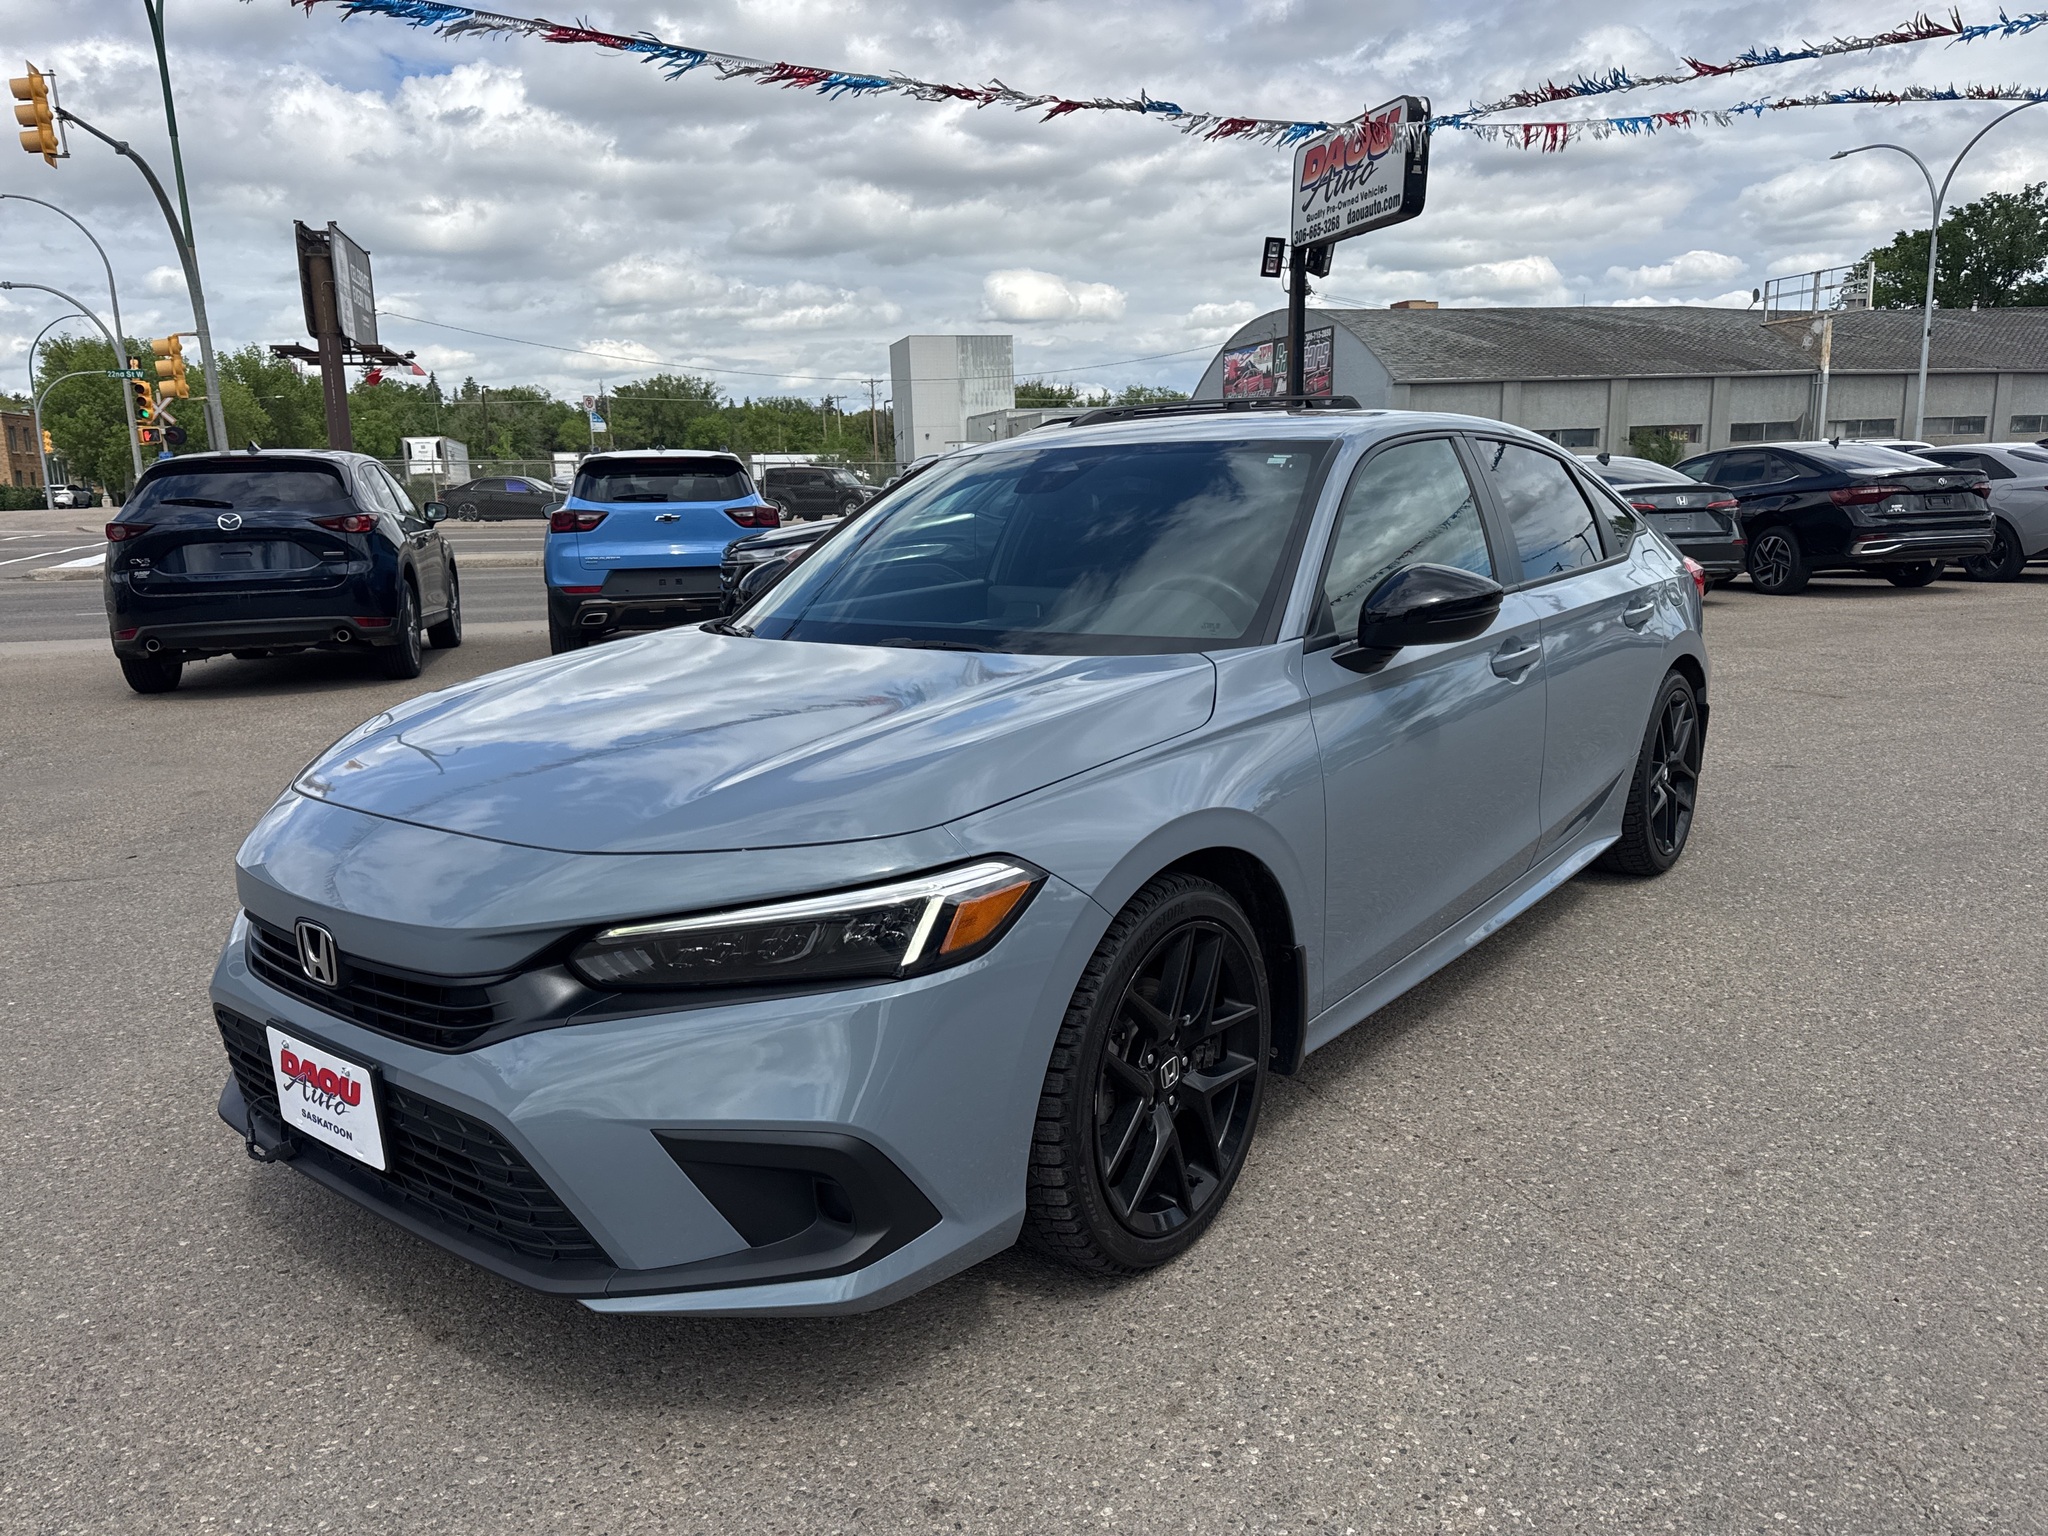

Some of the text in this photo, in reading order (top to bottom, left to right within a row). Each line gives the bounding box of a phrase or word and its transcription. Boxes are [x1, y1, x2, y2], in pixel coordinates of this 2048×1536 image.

[1300, 106, 1402, 192] DAOU
[1302, 160, 1379, 212] Auto
[1306, 184, 1388, 223] Quality Pre-Owned Vehicles
[1294, 193, 1401, 245] 306-665-3268 daouauto.com
[1668, 430, 1689, 441] SALE
[281, 1048, 361, 1107] DAOU
[283, 1072, 351, 1116] Auto
[301, 1108, 354, 1141] SASKATOON
